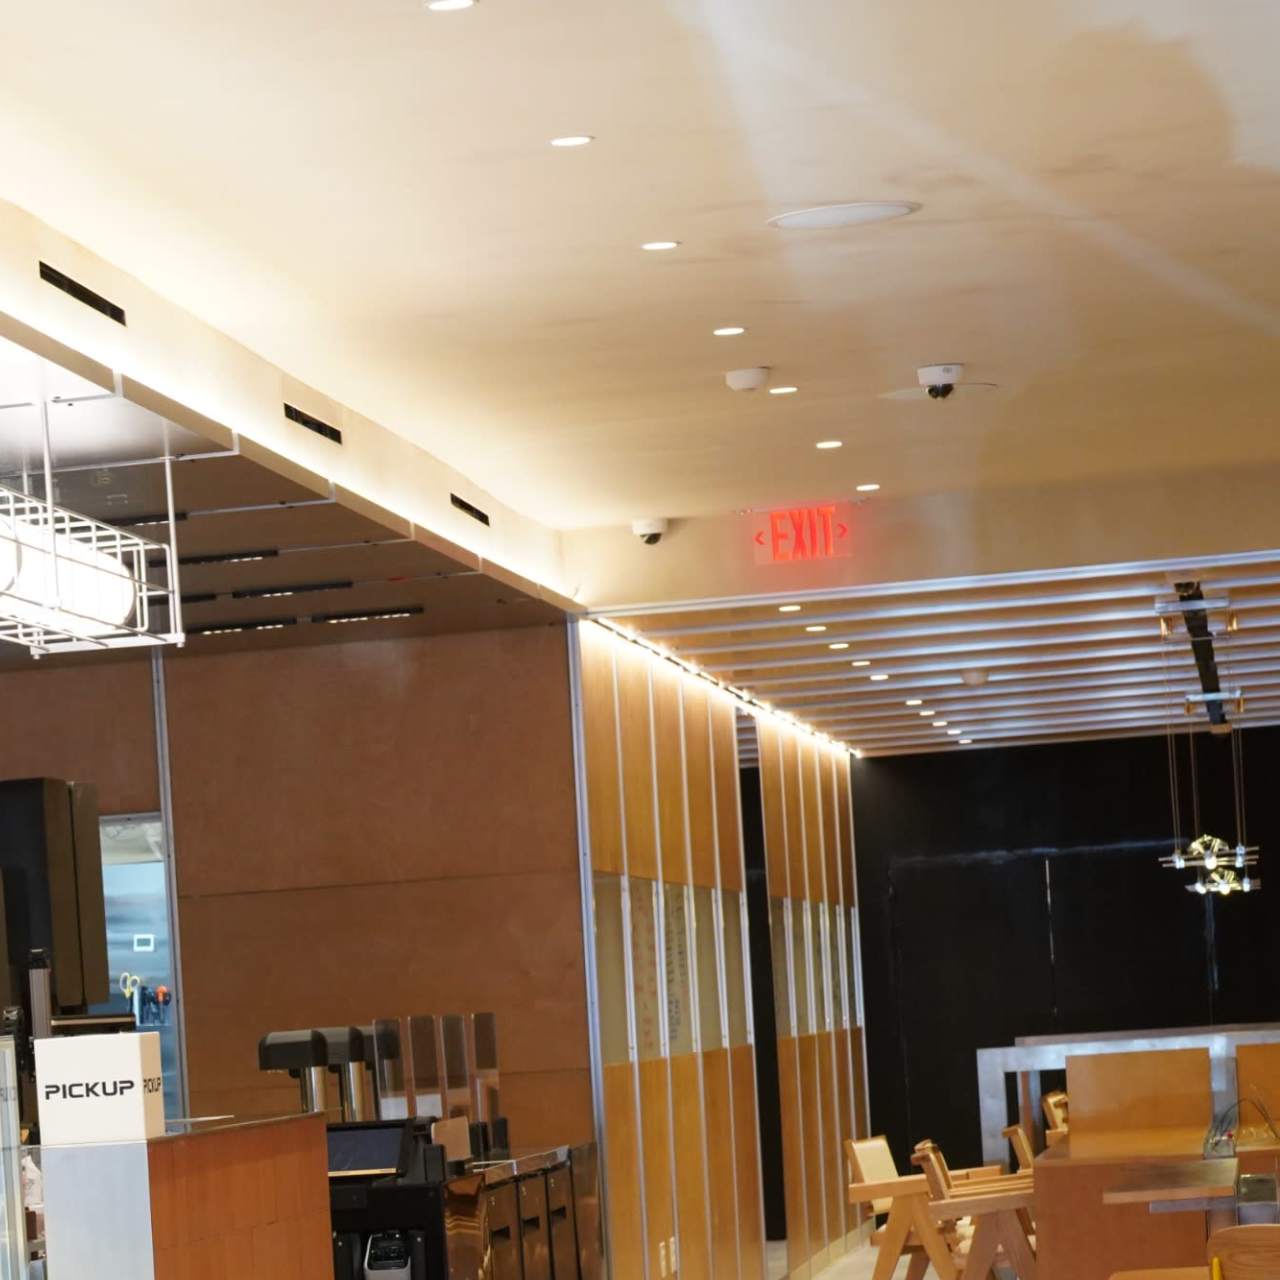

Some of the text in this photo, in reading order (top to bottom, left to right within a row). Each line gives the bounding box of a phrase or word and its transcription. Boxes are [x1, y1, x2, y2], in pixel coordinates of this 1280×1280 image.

[770, 505, 836, 561] EXIT
[45, 1079, 135, 1101] PICKUP
[143, 1076, 161, 1094] PICKUP
